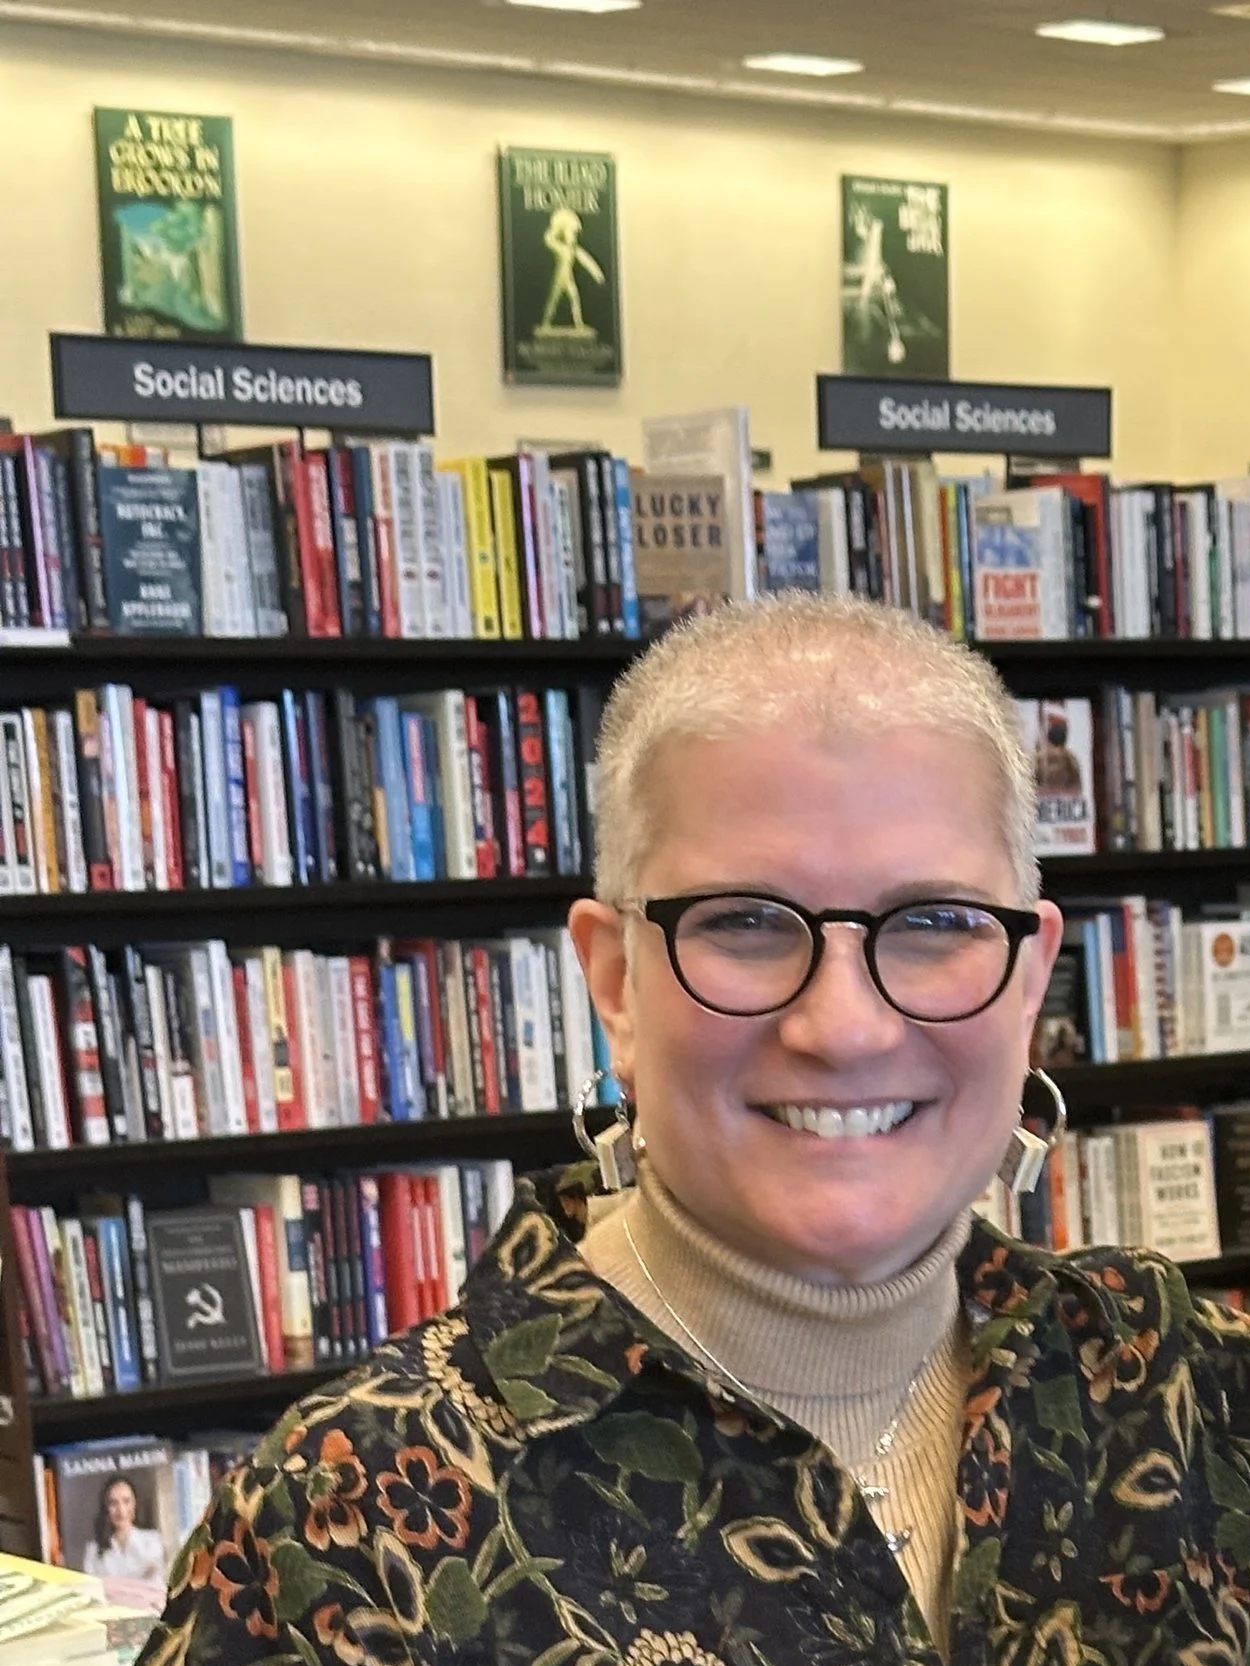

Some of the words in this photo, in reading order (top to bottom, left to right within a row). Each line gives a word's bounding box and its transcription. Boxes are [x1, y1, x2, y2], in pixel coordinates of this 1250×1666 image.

[133, 362, 225, 401] Social
[232, 369, 363, 408] Sciences
[879, 397, 950, 431] Social
[955, 401, 1056, 436] Sciences
[635, 493, 720, 519] LUCKY
[637, 523, 722, 549] LOSER
